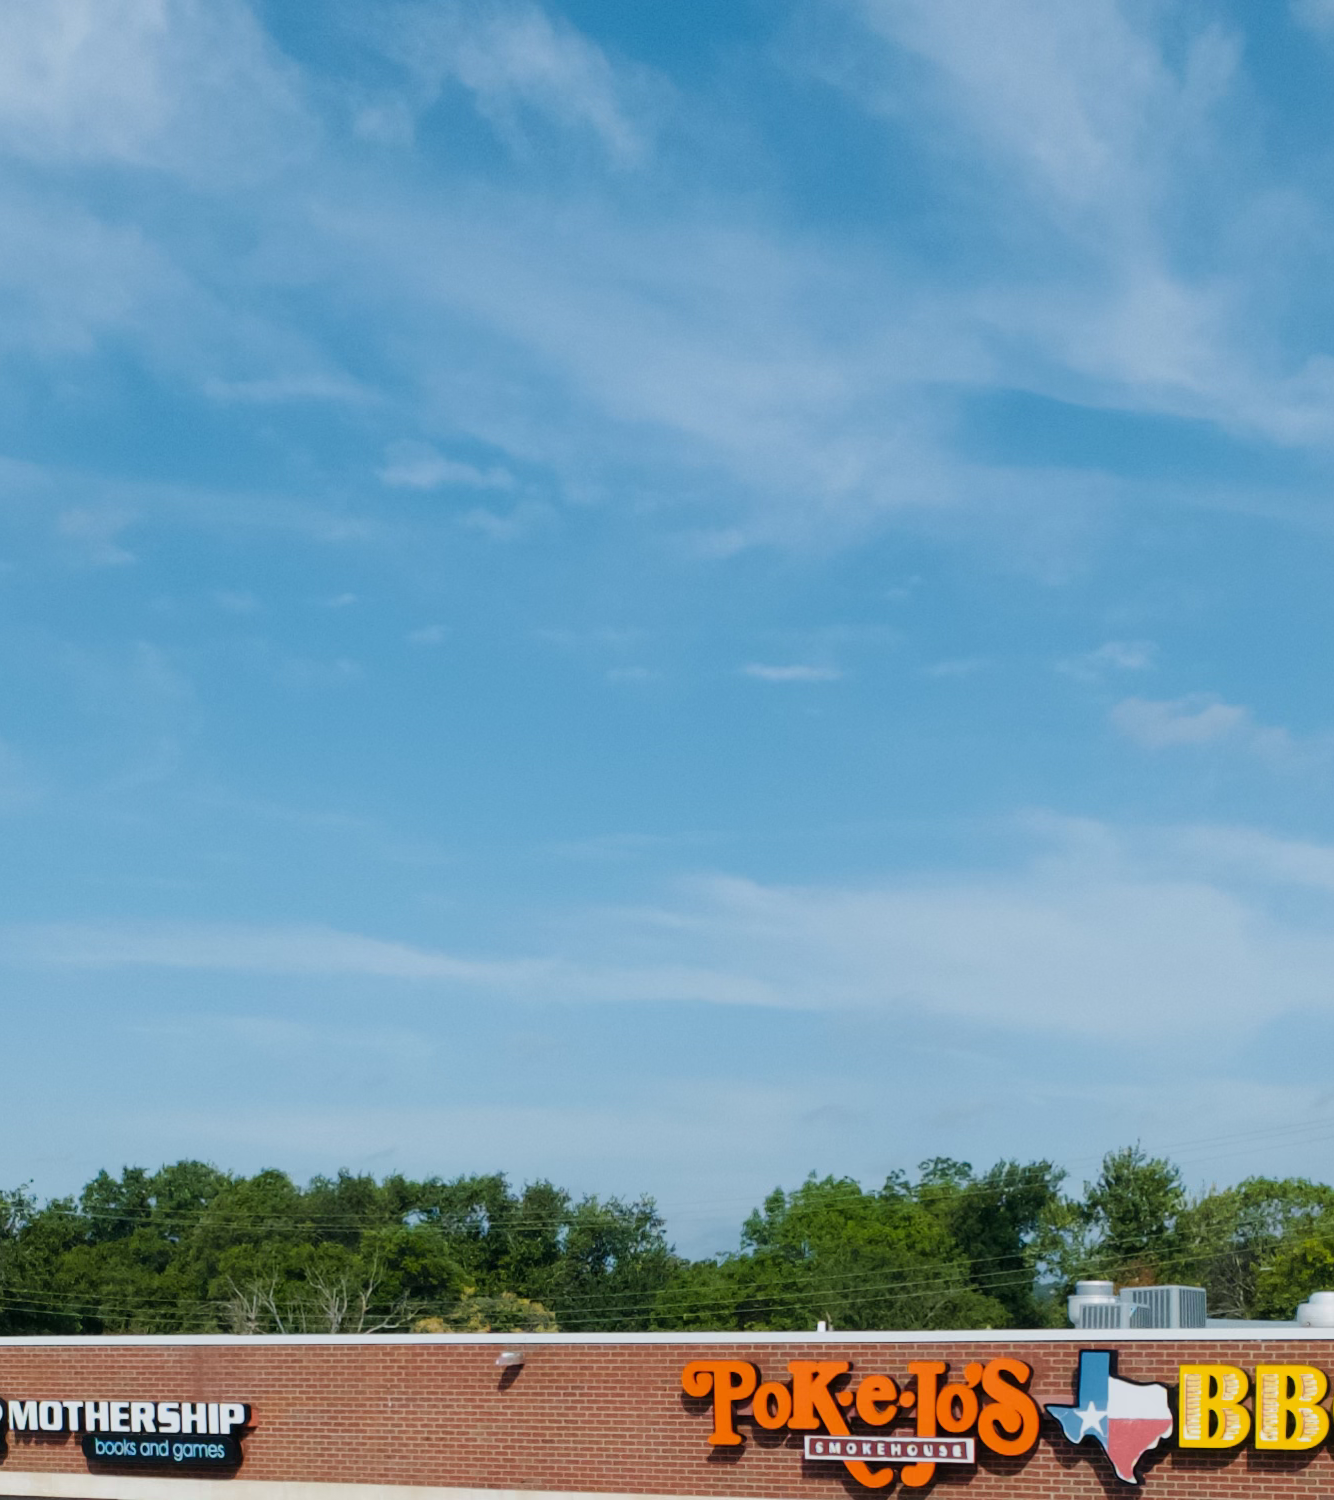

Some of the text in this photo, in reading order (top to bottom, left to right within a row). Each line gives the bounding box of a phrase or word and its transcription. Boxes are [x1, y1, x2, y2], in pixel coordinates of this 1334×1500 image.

[8, 1400, 247, 1435] MOTHERSHIP
[95, 1437, 225, 1462] books and games
[814, 1440, 963, 1458] SMOKEHOUSE
